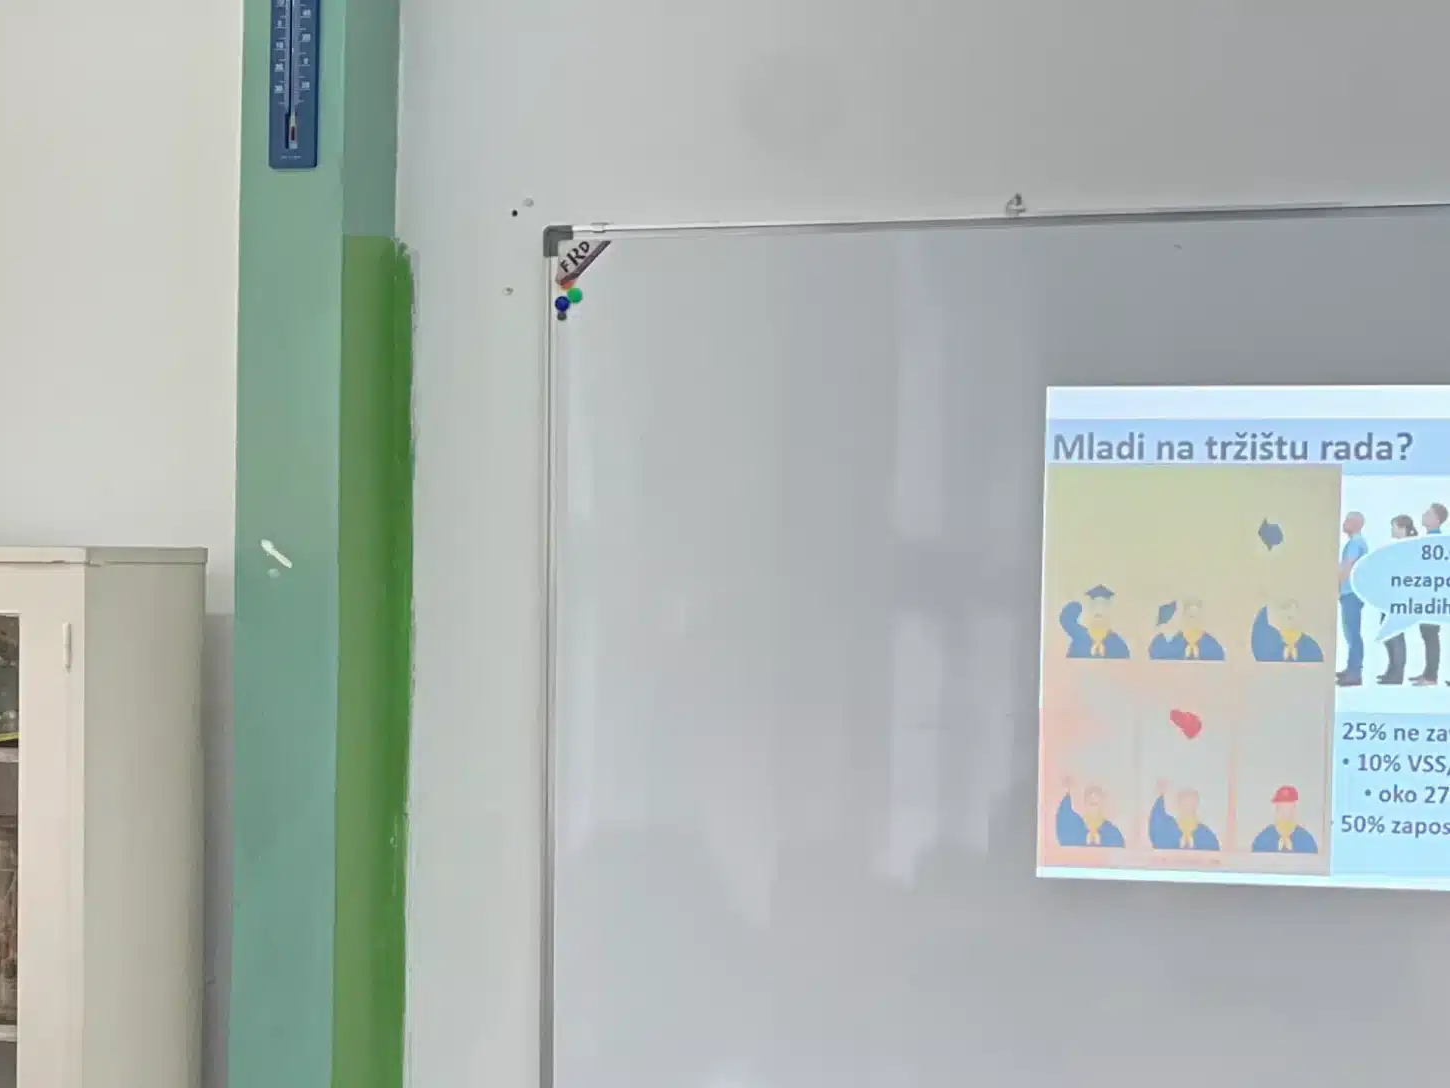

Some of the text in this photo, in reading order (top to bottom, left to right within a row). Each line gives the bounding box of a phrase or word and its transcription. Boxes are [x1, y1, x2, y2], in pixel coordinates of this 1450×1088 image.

[1053, 431, 1414, 461] Mladi na tržištu rada?
[1421, 544, 1450, 561] 80.
[1341, 722, 1450, 742] 25% ne za
[1357, 753, 1402, 772] 10%
[1378, 784, 1417, 803] oko
[1340, 814, 1386, 834] 50%
